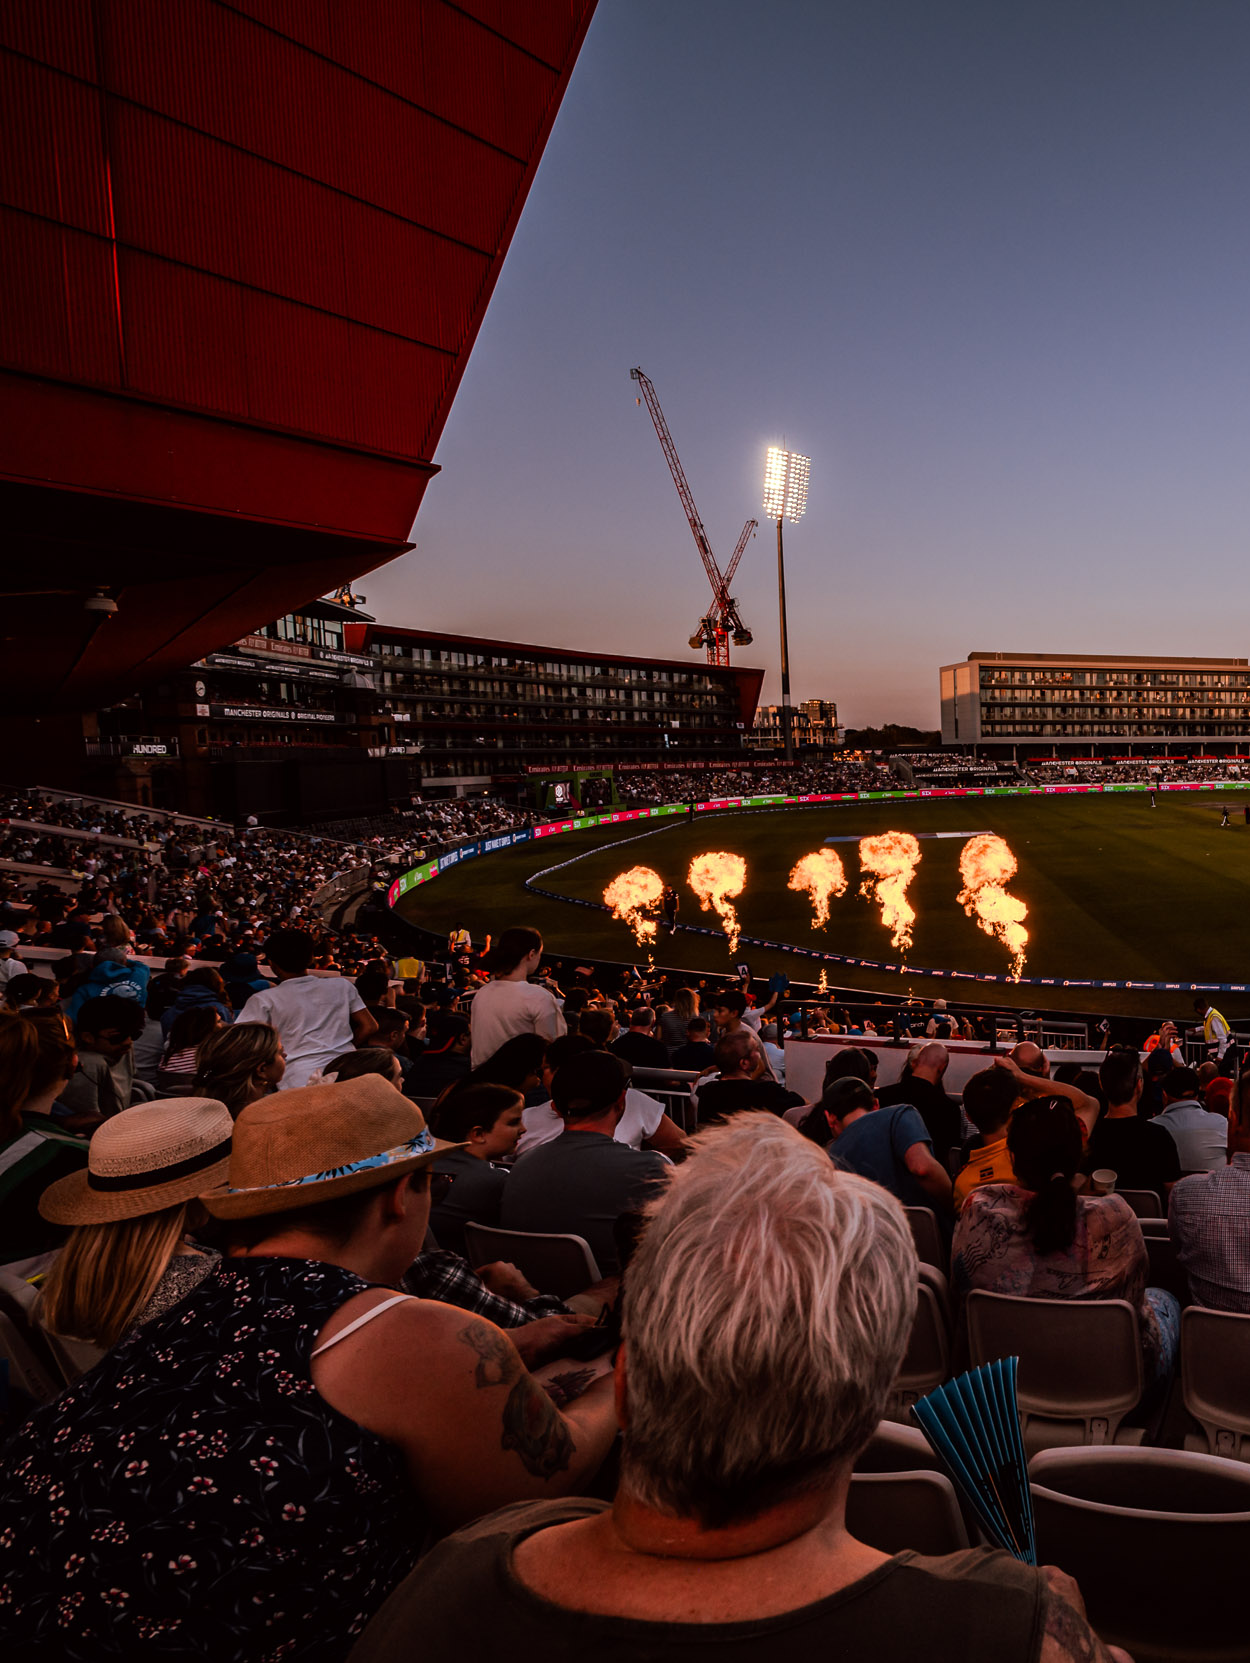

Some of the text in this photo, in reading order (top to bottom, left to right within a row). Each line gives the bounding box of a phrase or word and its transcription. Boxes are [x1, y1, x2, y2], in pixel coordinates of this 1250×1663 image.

[224, 707, 290, 719] MANCHESTER ORIGINALS
[133, 744, 168, 754] HUNDRED
